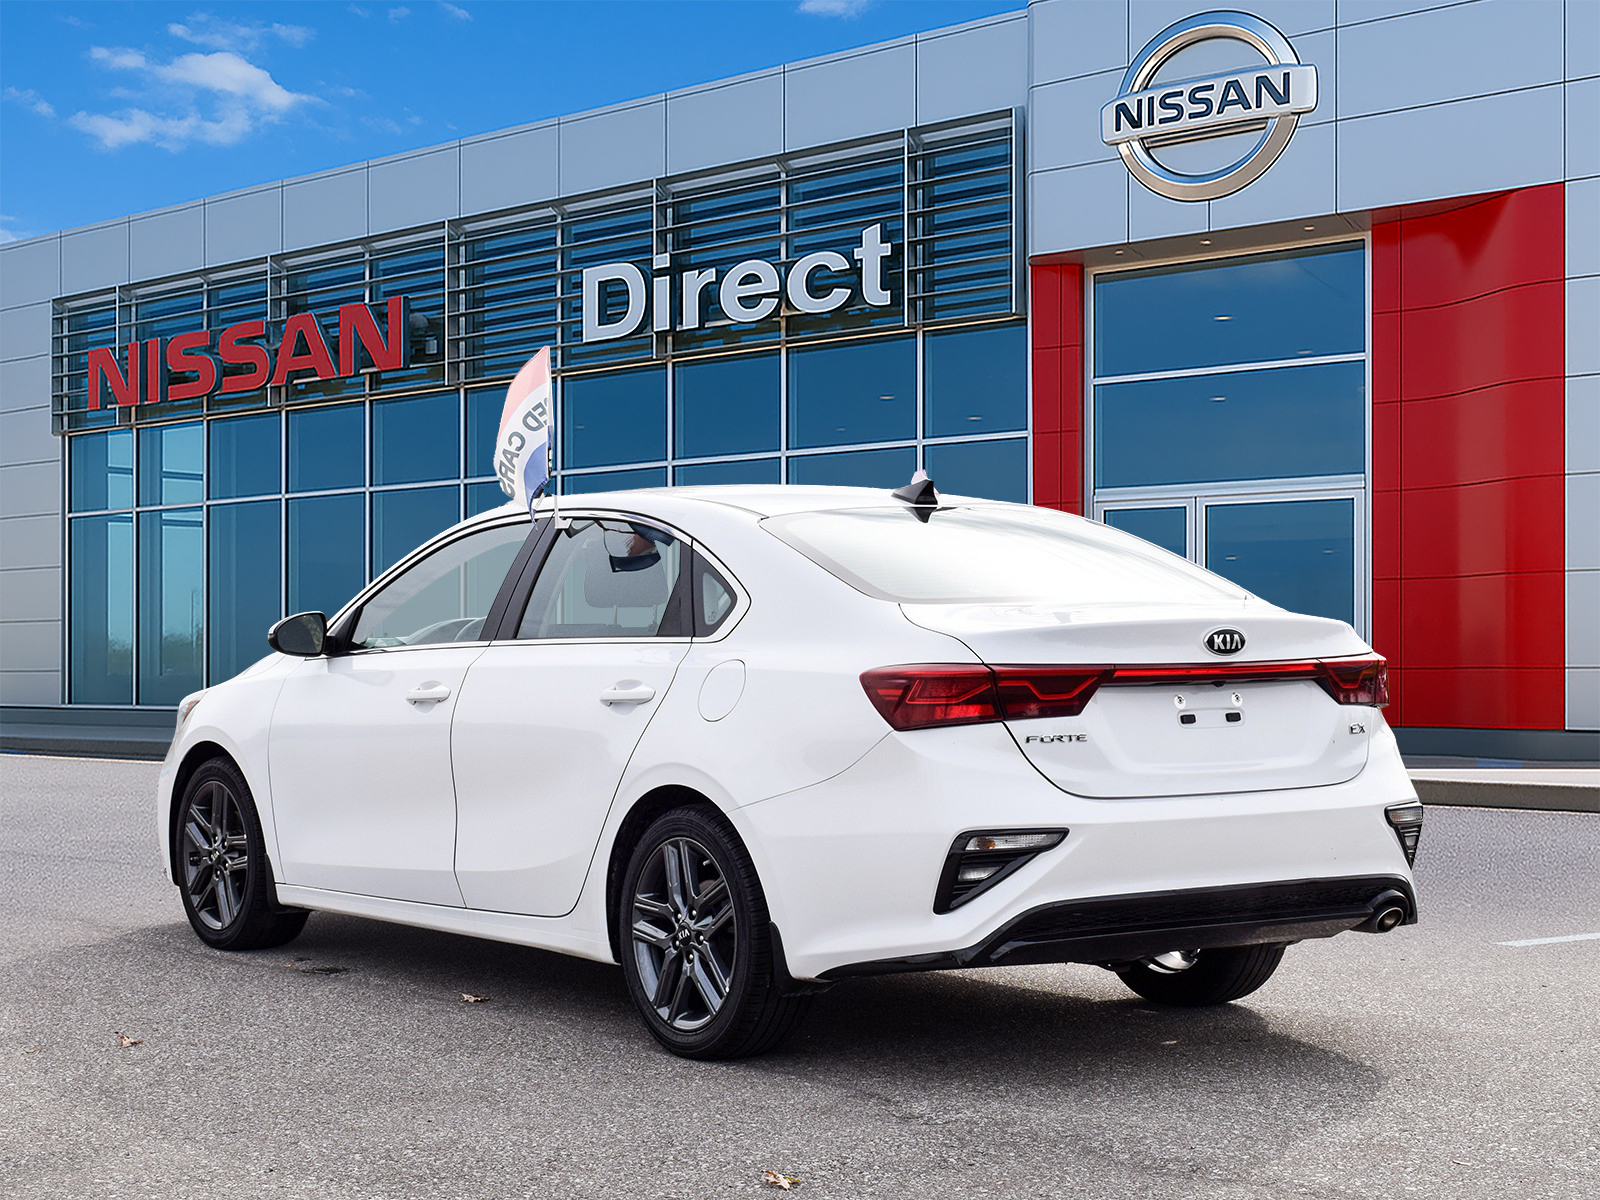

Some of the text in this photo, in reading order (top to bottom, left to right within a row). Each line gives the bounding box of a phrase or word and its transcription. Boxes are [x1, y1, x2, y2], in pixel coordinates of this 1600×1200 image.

[1114, 71, 1291, 132] NISSAN
[87, 222, 893, 410] NISSAN Direct
[1212, 633, 1242, 650] KIA
[1349, 722, 1366, 735] EX
[1025, 733, 1088, 744] FORTE
